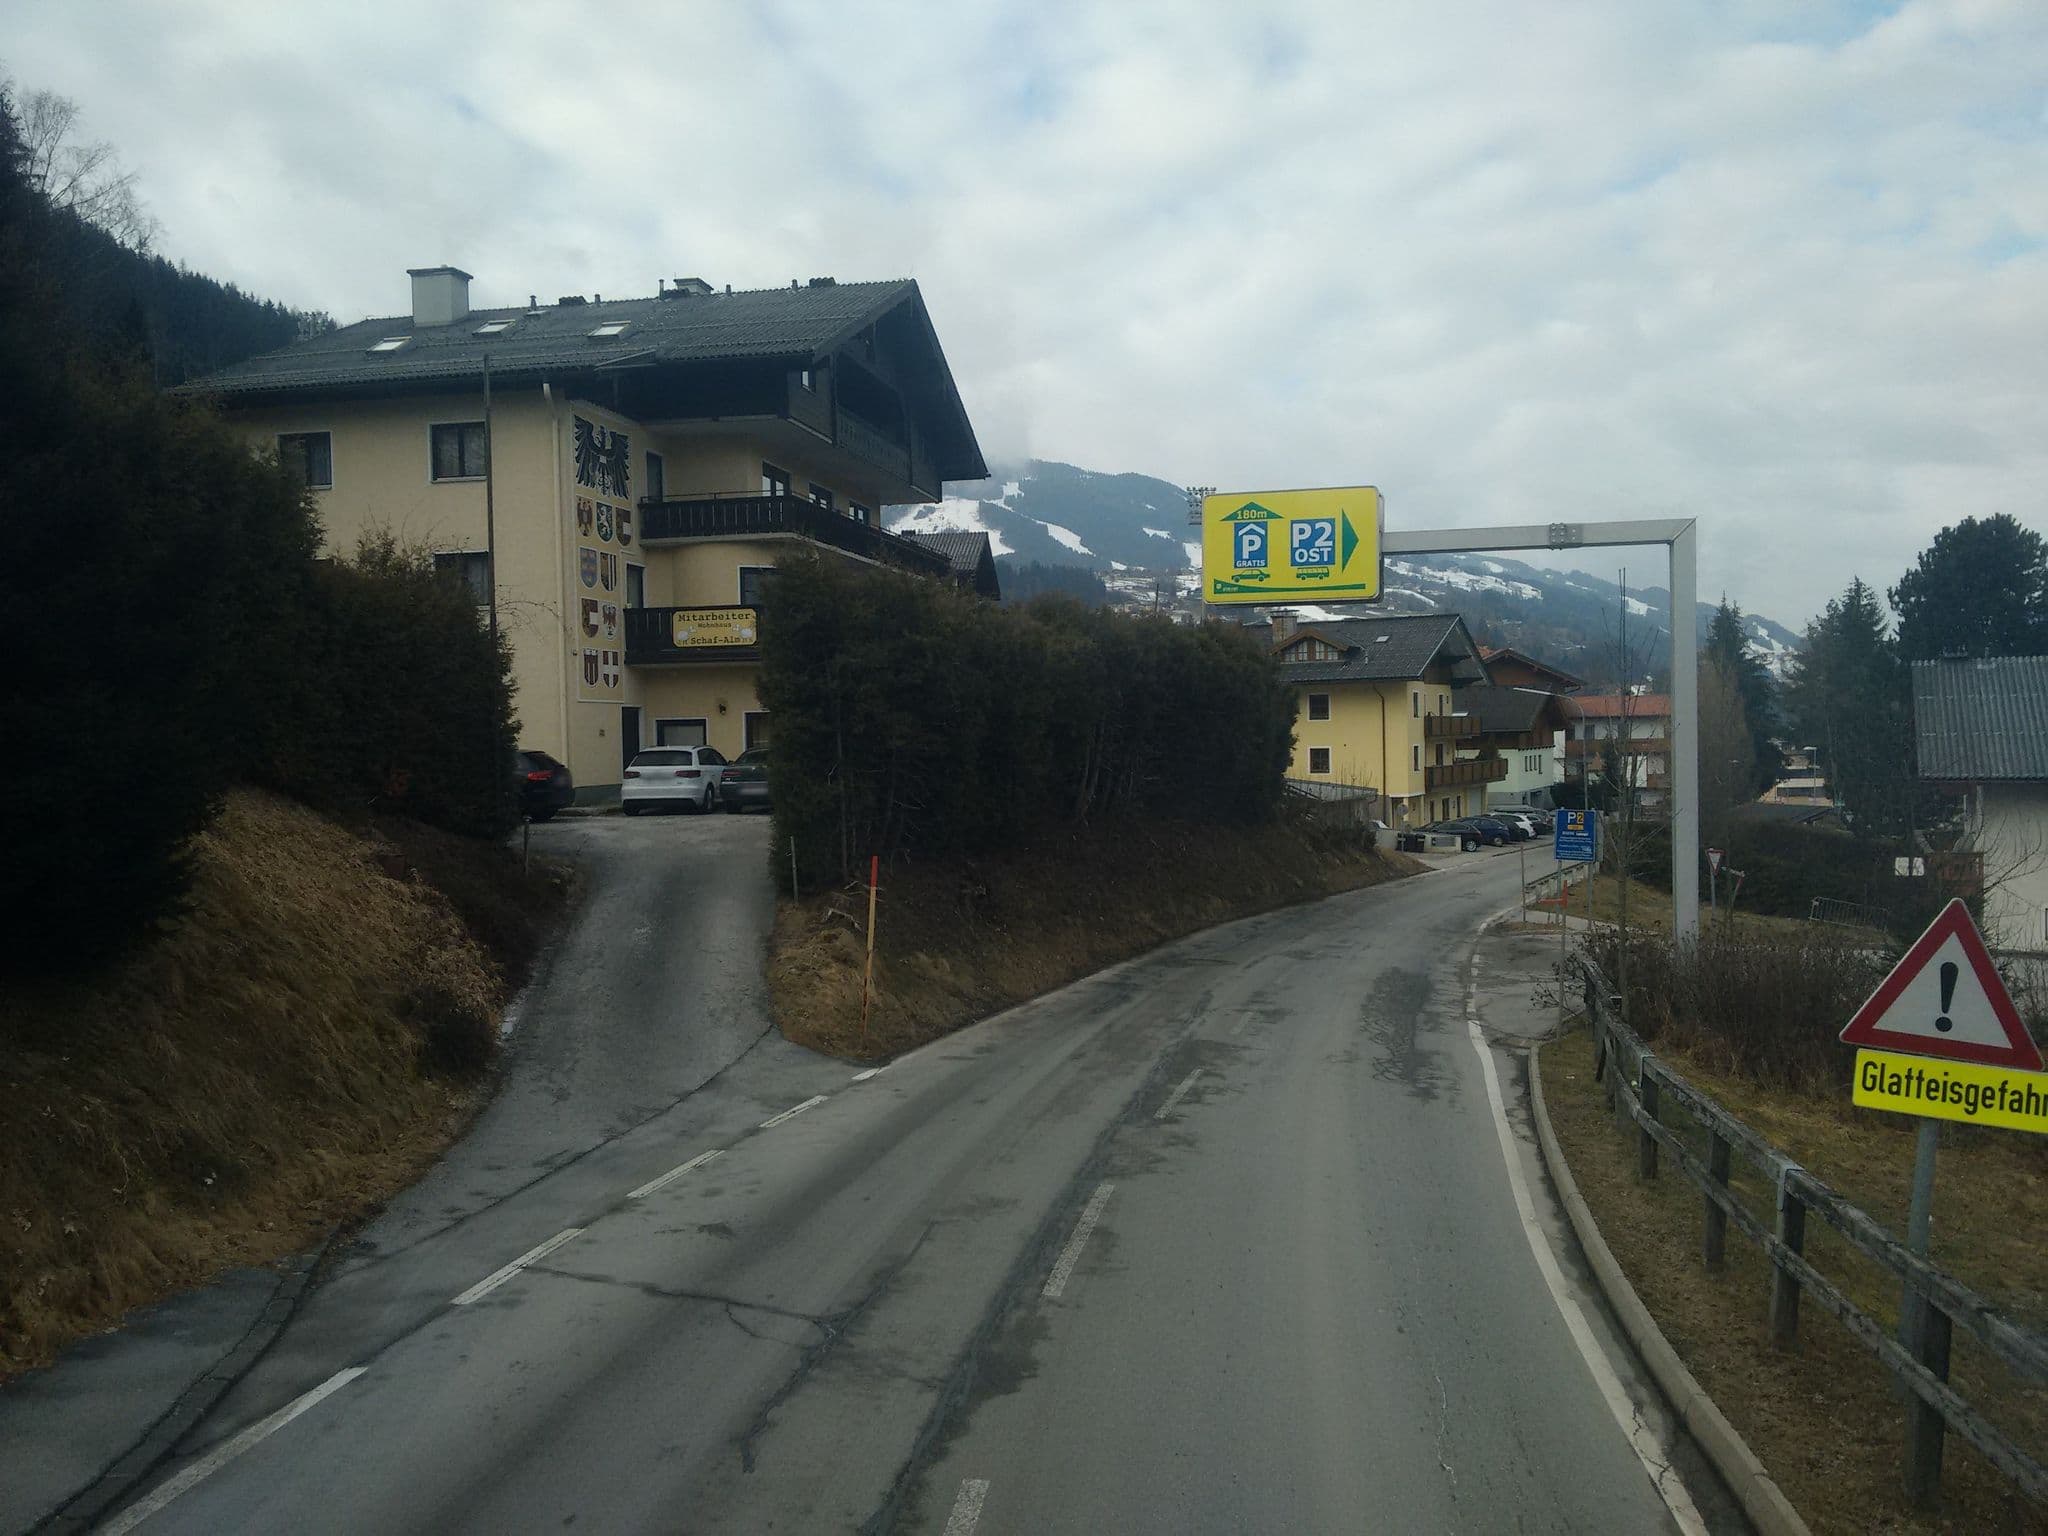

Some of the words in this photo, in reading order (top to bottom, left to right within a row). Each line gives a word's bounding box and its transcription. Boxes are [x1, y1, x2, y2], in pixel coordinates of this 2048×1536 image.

[1236, 509, 1268, 520] 180m
[1292, 522, 1333, 548] P2
[1242, 534, 1262, 559] P
[1294, 547, 1332, 563] OST
[1236, 559, 1266, 568] GRATIS
[678, 612, 751, 622] Mitarbeiter
[690, 636, 741, 645] Schaf-Alm
